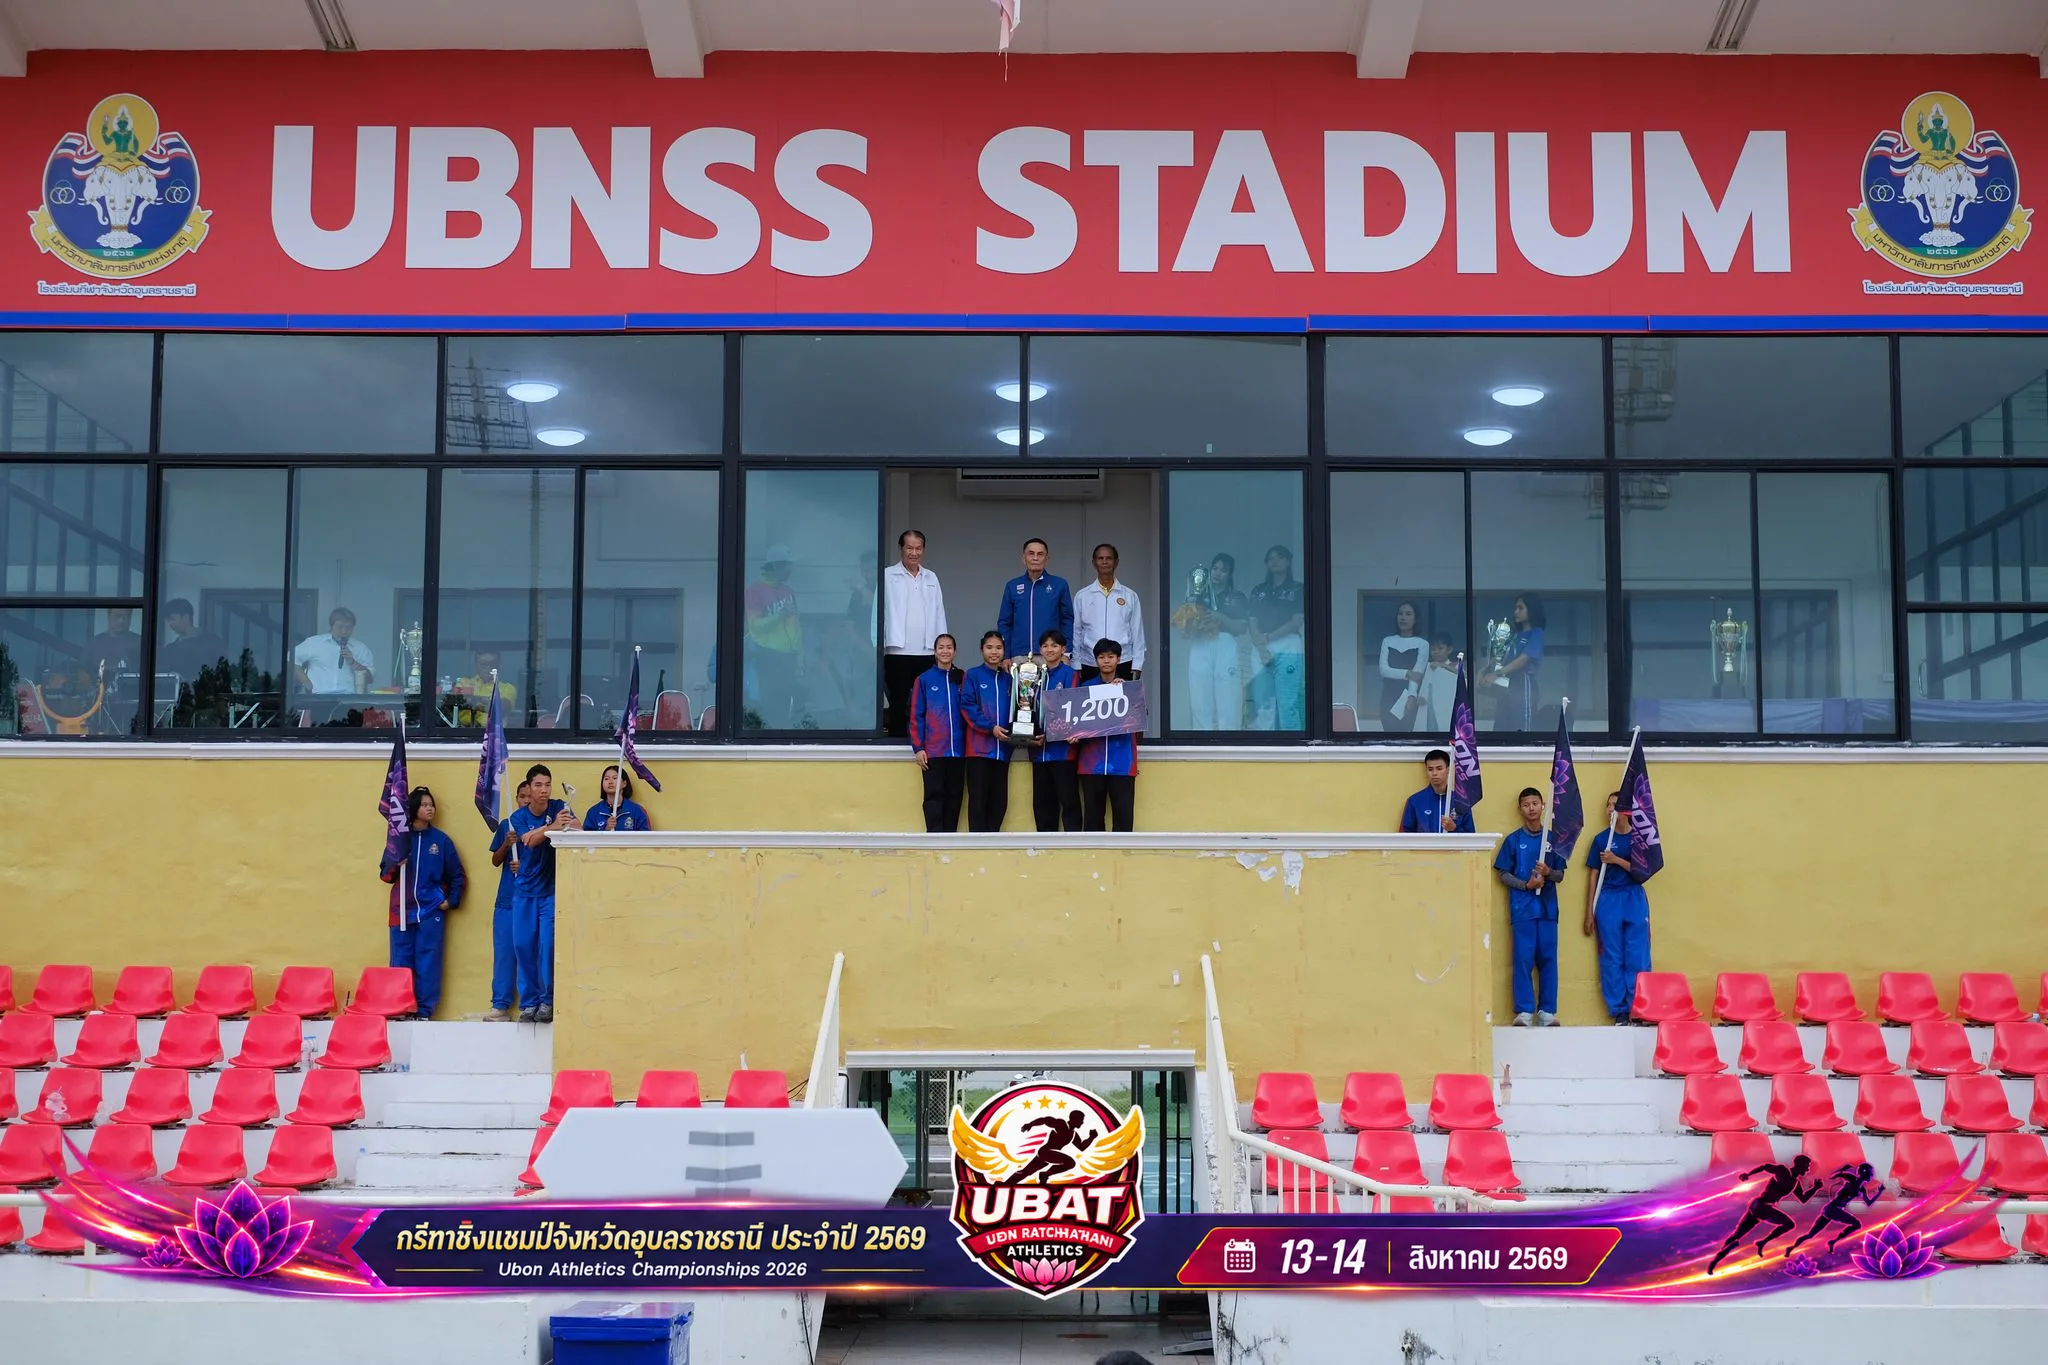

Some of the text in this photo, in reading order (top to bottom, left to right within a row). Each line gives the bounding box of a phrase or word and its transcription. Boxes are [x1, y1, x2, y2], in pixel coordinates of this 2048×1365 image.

[271, 125, 1791, 277] UBNSS STADIUM
[39, 282, 195, 298] โรงเรียนกีฬาจังหวัดอุบลราชธานี
[1864, 281, 2022, 297] โรงเรียนกีฬาจังหวัดอุบลราชธานี
[1061, 694, 1130, 725] 1,200
